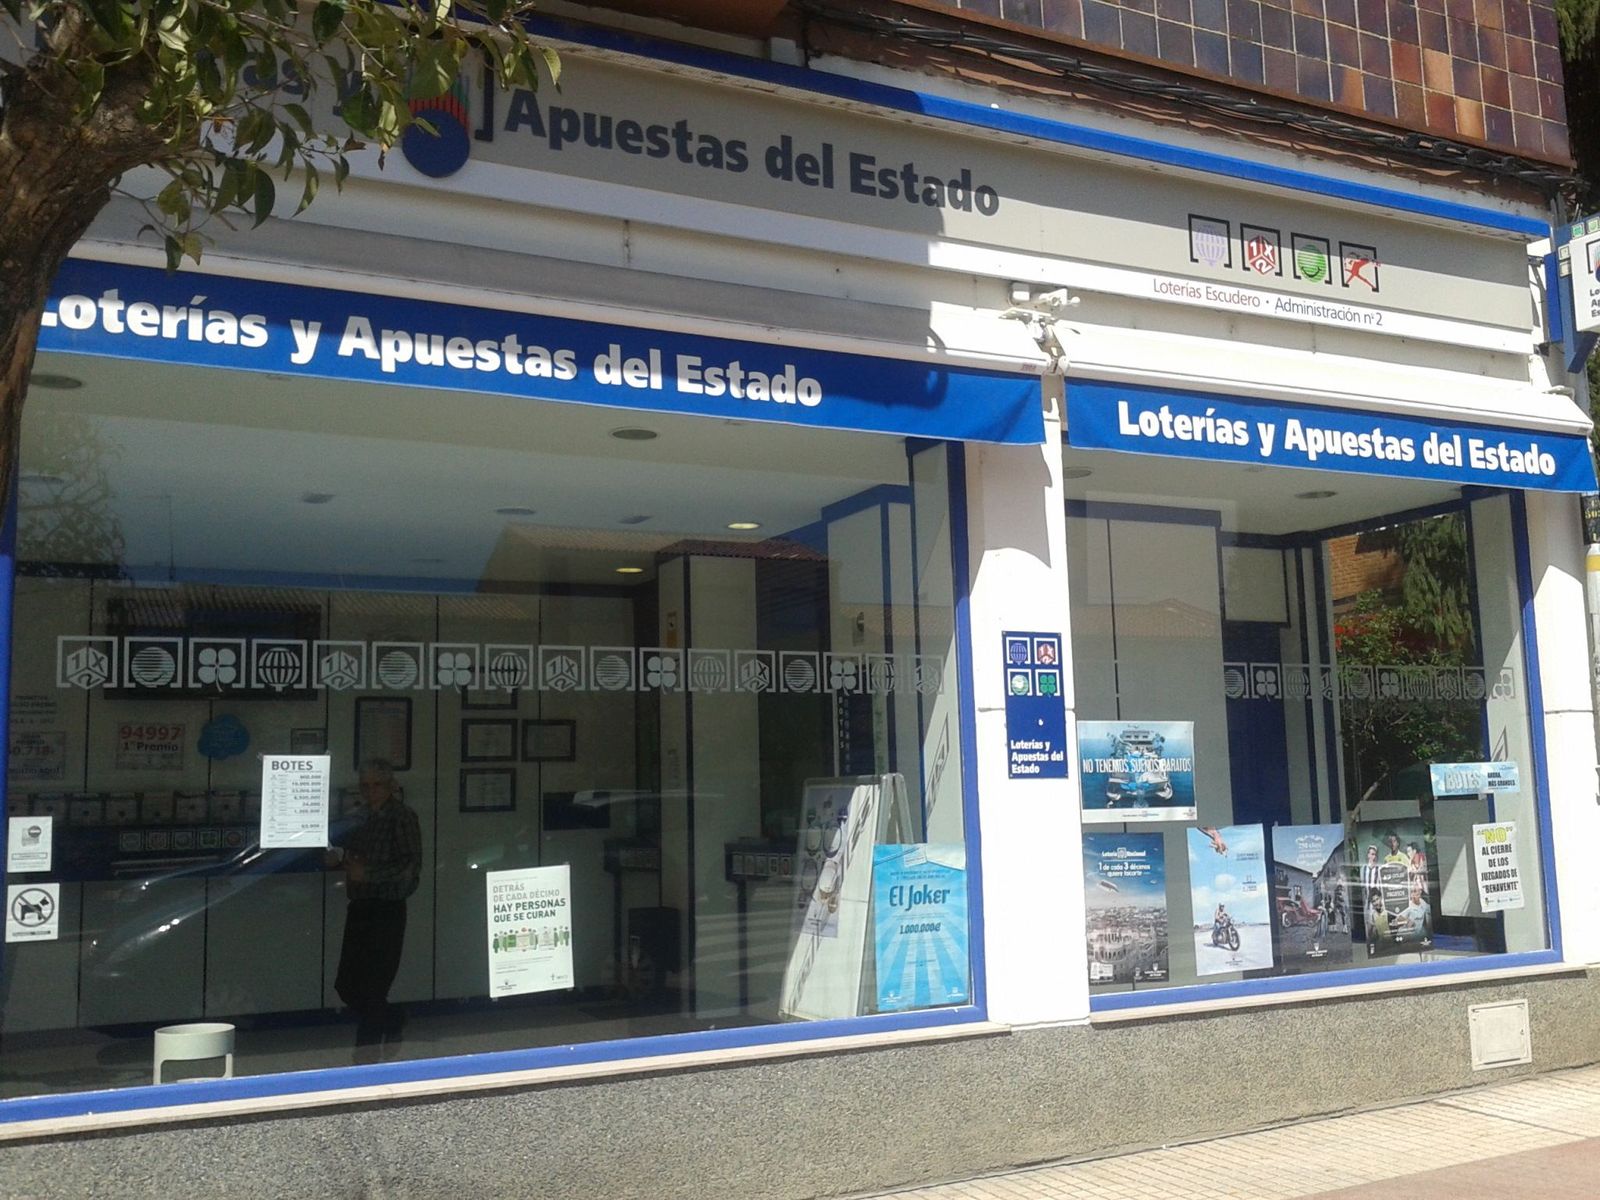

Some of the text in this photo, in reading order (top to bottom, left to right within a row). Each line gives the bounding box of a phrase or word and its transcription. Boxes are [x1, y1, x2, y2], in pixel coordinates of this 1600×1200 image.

[504, 88, 1000, 217] Apuestas del Estado
[1153, 278, 1201, 299] Loterías
[1206, 286, 1260, 307] Escudero
[1275, 297, 1361, 324] Administración
[290, 318, 321, 365] y
[338, 316, 578, 381] Apuestas
[593, 343, 662, 390] del
[676, 354, 822, 407] Estado
[1118, 401, 1556, 476] Loterías y Apuestas del Estado
[121, 726, 180, 740] 94997
[137, 741, 178, 751] Premio
[1010, 739, 1050, 752] Loterías y
[1011, 751, 1064, 764] Apuestas del
[272, 760, 313, 771] BOTES
[1012, 764, 1040, 774] Estado
[1083, 759, 1093, 773] NO
[1095, 759, 1129, 773] TENEMOS
[1482, 843, 1512, 856] AL CIERRE
[1099, 862, 1103, 870] 1
[1124, 861, 1129, 870] 3
[1488, 857, 1509, 868] DE LOS
[1481, 868, 1518, 881] JUZGADOS DE
[493, 882, 525, 894] DETRÁS
[493, 888, 560, 903] DE CADA DÉCIMO
[889, 884, 950, 911] El Joker
[494, 898, 566, 913] HAY PERSONAS
[494, 909, 556, 923] QUE SE CURAN
